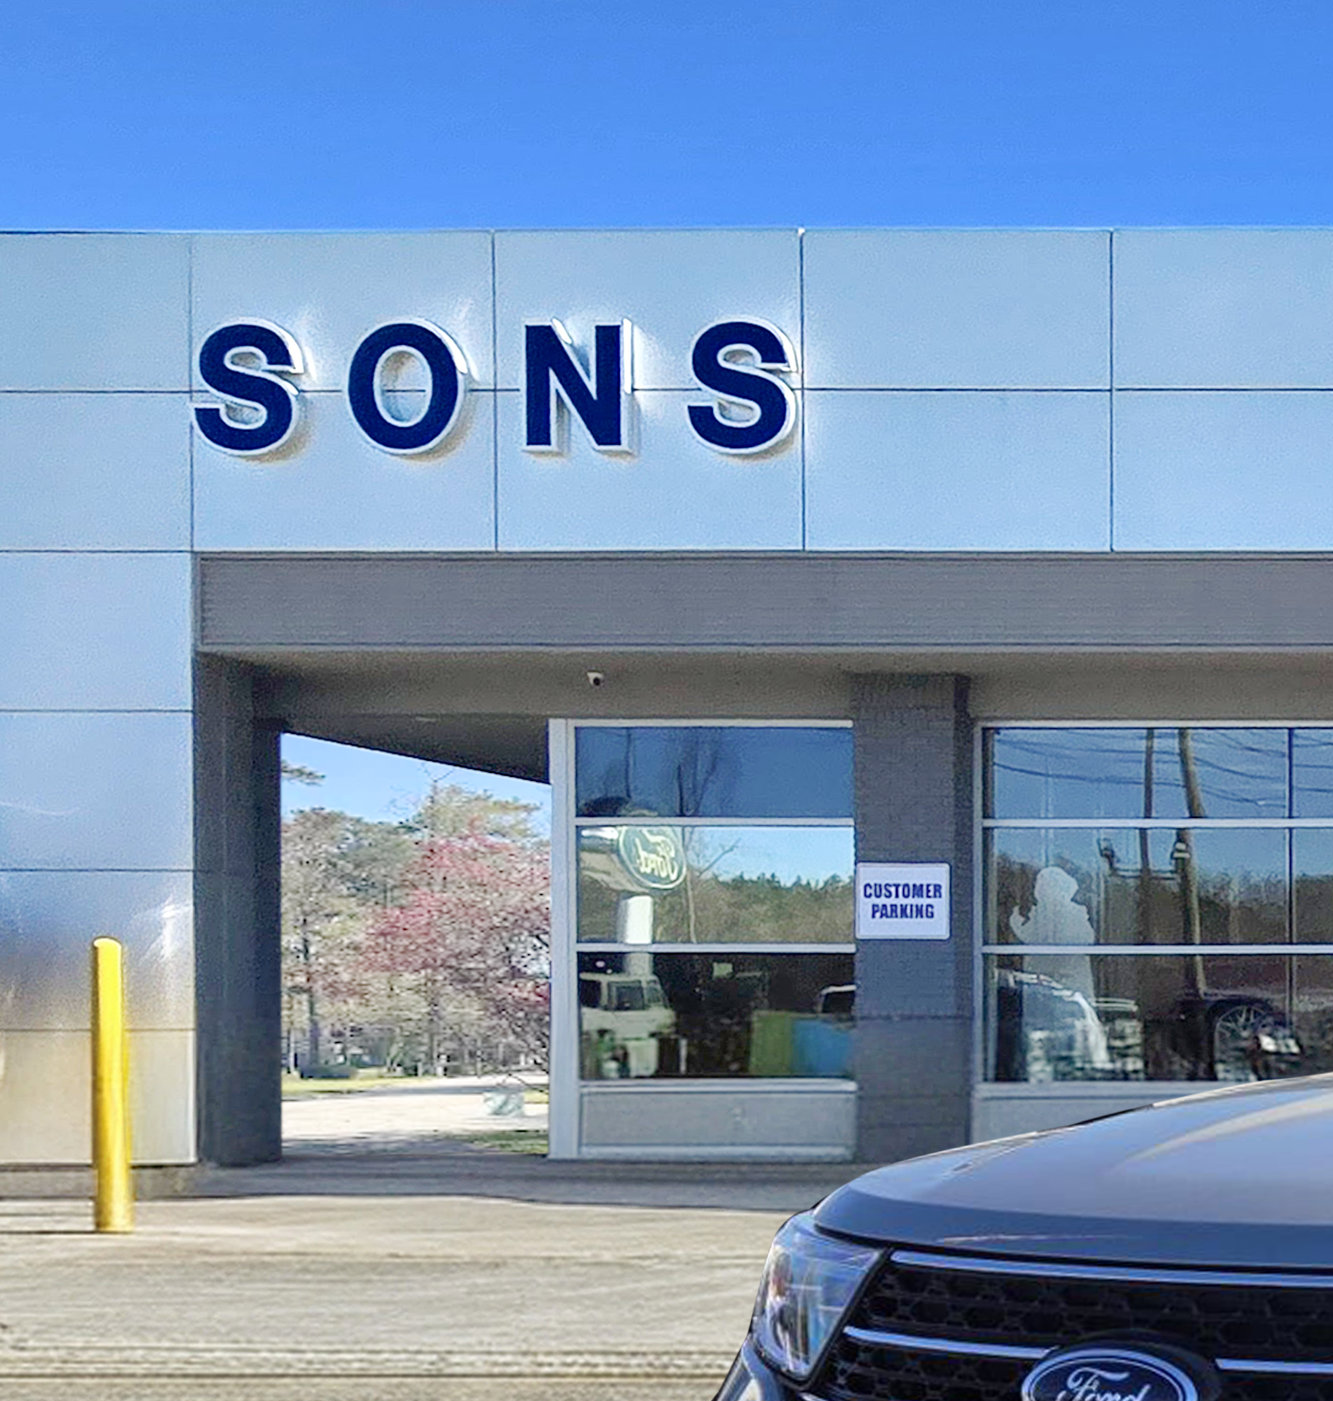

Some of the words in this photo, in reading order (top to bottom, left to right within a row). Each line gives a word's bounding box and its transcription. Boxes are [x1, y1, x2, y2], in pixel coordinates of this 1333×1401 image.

[193, 319, 794, 453] SONS
[863, 882, 943, 899] CUSTOMER
[871, 903, 935, 919] PARKING
